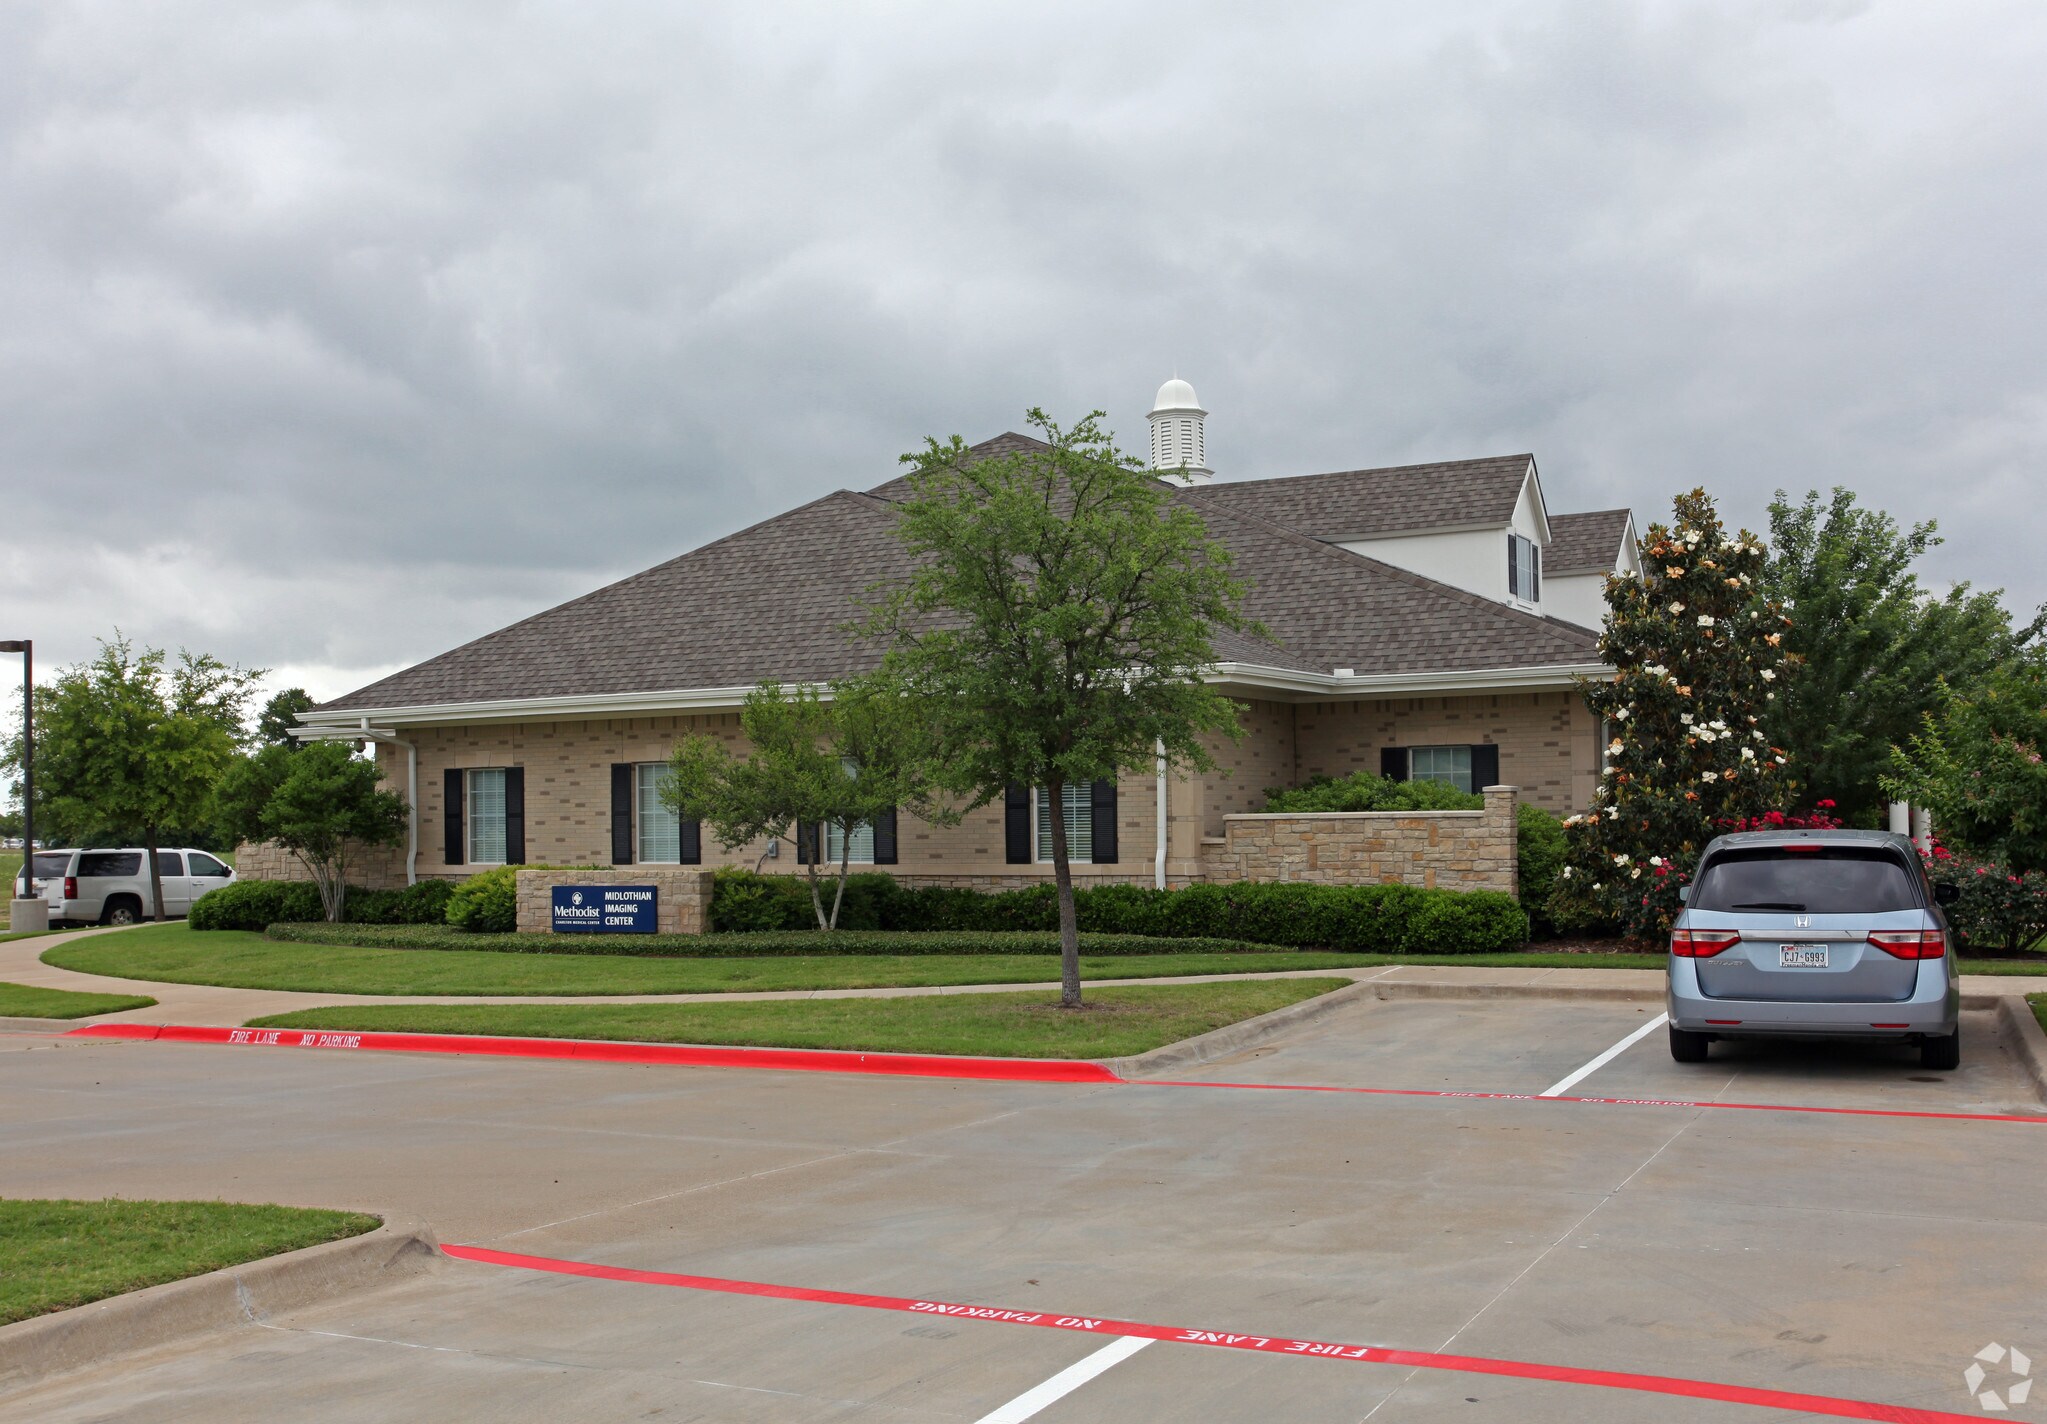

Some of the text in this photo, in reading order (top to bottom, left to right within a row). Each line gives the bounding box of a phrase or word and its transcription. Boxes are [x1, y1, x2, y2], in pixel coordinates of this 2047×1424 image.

[605, 891, 652, 901] MIDLOTHIAN
[554, 905, 600, 917] Methodist
[605, 904, 638, 913] IMAGING
[605, 916, 634, 926] CENTER
[228, 1030, 361, 1048] FIRE LANE NO PARKING
[1615, 1099, 1696, 1107] PARKING
[909, 1302, 1369, 1358] FIRE LANE NO PARKING
